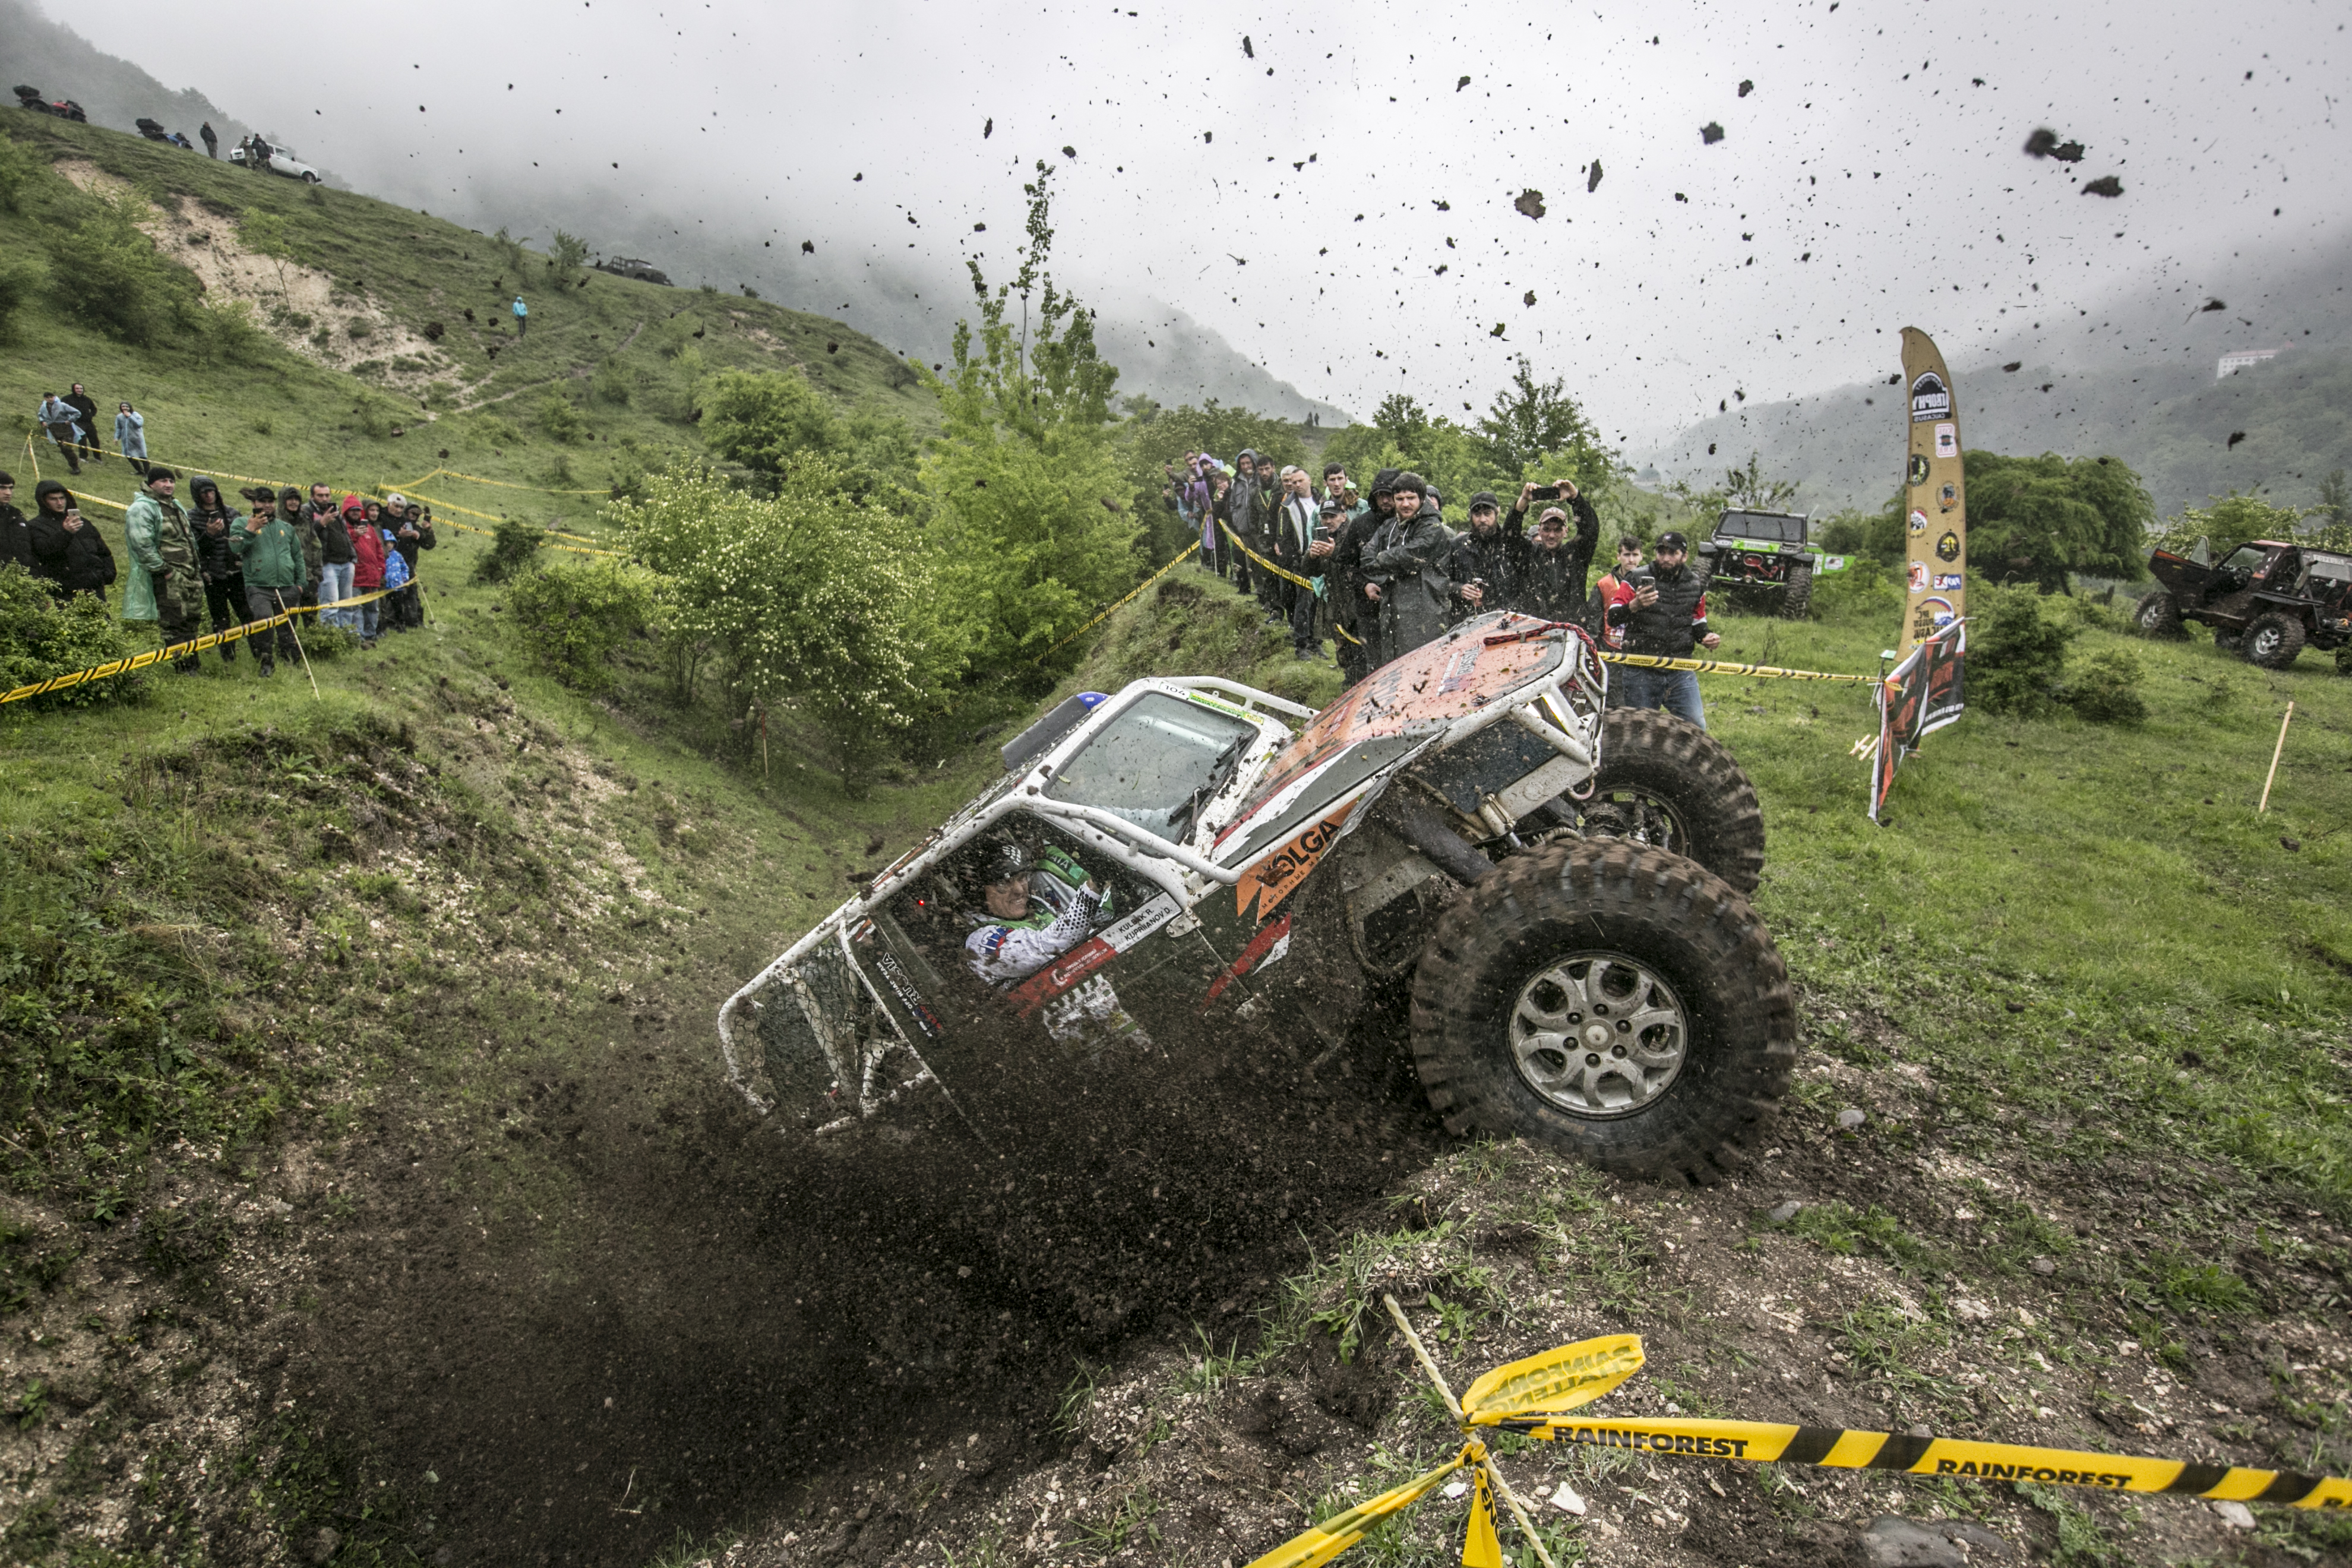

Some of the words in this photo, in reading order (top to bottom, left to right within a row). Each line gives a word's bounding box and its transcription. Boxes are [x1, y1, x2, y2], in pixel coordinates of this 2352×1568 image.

[1456, 646, 1480, 675] RUSSIA
[1165, 685, 1186, 696] 104
[1309, 856, 1320, 867] МА
[1118, 913, 1146, 933] KULBAK
[1124, 911, 1164, 941] KUPRIIANOV
[877, 962, 890, 979] TEAM
[883, 952, 922, 1006] RUSSIA
[902, 997, 912, 1009] OFF
[1074, 991, 1097, 1010] CUCASUS
[1554, 1427, 1748, 1458] RAINFOREST
[1937, 1459, 2132, 1487] RAINFOREST
